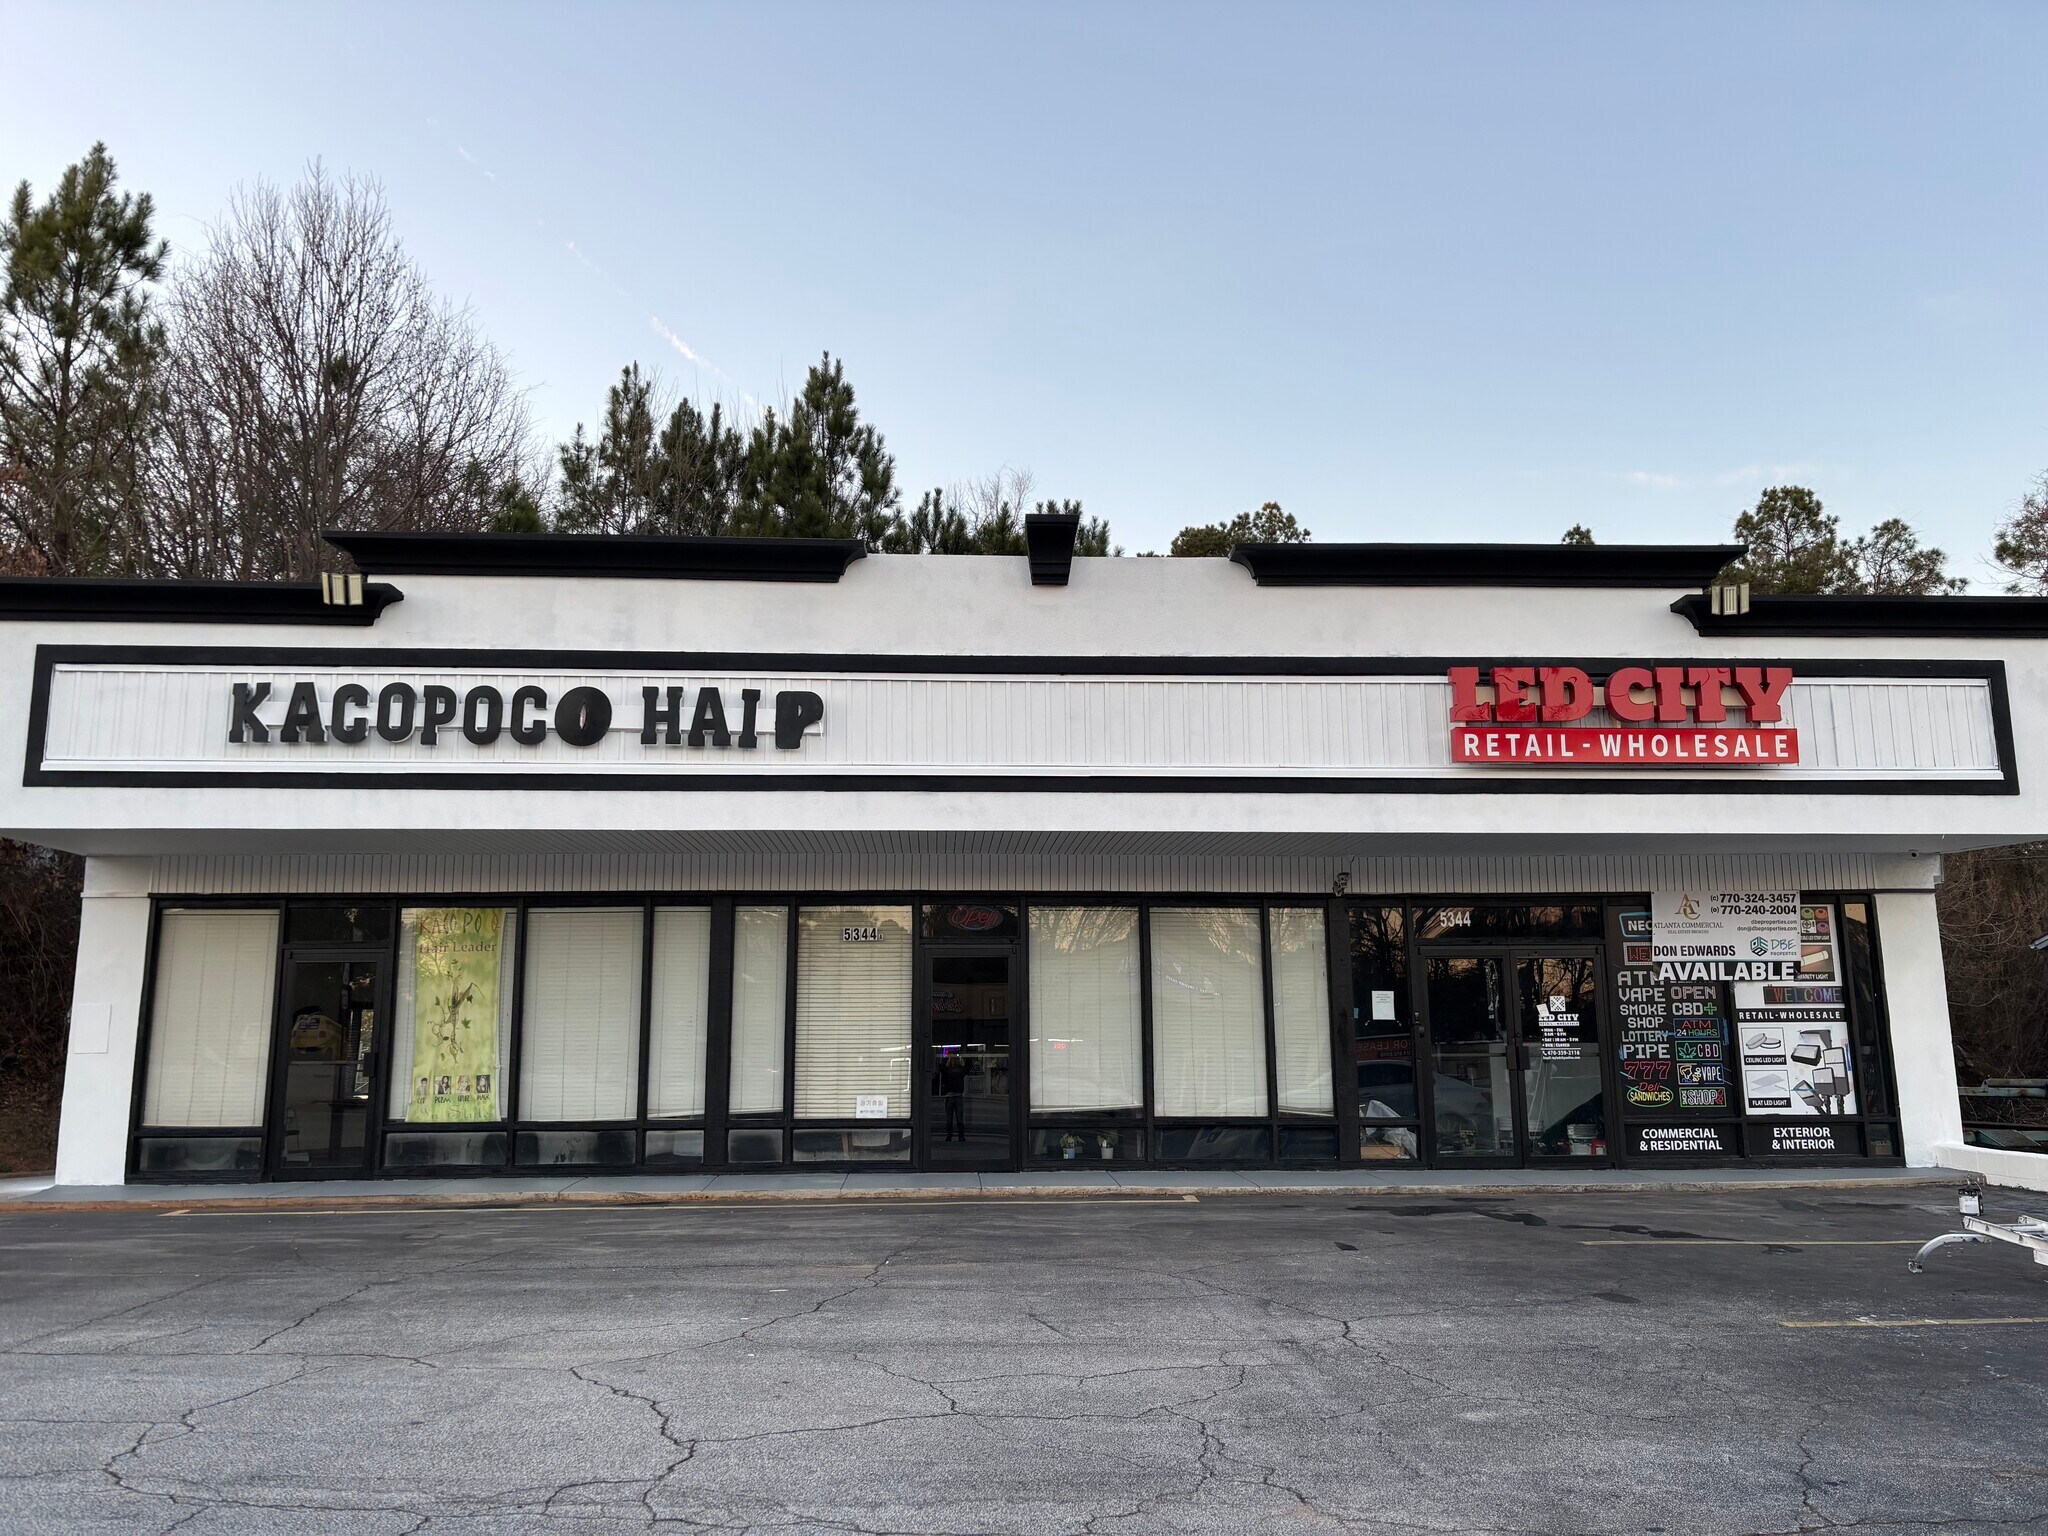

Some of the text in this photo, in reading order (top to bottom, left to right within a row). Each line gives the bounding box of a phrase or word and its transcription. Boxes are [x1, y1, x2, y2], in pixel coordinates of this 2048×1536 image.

[1447, 666, 1794, 723] LED CITY
[228, 681, 612, 747] KACOPOCO
[1464, 733, 1574, 757] RETAIL
[1599, 734, 1789, 758] WHOLESALE
[1719, 893, 1797, 903] 770-324-3457
[1720, 905, 1797, 915] 770-240-2004
[1439, 911, 1472, 927] 5344
[844, 928, 876, 941] 5344
[453, 941, 497, 952] Leader
[1771, 938, 1796, 950] DBE
[1654, 945, 1736, 957] DON EDWARDS
[1659, 962, 1795, 980] AVAILABLE
[1618, 987, 1666, 1002] VAPE
[1670, 986, 1717, 999] OPEN
[1620, 1004, 1667, 1016] SMOKE
[1557, 1013, 1579, 1021] CITY
[1627, 1017, 1664, 1028] SHOP
[1681, 1020, 1712, 1029] ATM
[1621, 1030, 1669, 1042] LOTTERY
[1676, 1029, 1686, 1037] 24
[1623, 1044, 1671, 1059] PIPE
[1697, 1043, 1719, 1058] CBD
[1624, 1060, 1671, 1080] 777
[1701, 1066, 1721, 1081] VAPE
[1639, 1082, 1660, 1092] Deli
[1629, 1091, 1671, 1102] SANDWICHES
[1687, 1089, 1718, 1105] SHOP
[1642, 1128, 1718, 1139] COMMERCIAL
[1773, 1127, 1831, 1137] EXTERIOR
[1640, 1140, 1723, 1151] & RESIDENTIAL
[1771, 1139, 1835, 1149] & INTERIOR
